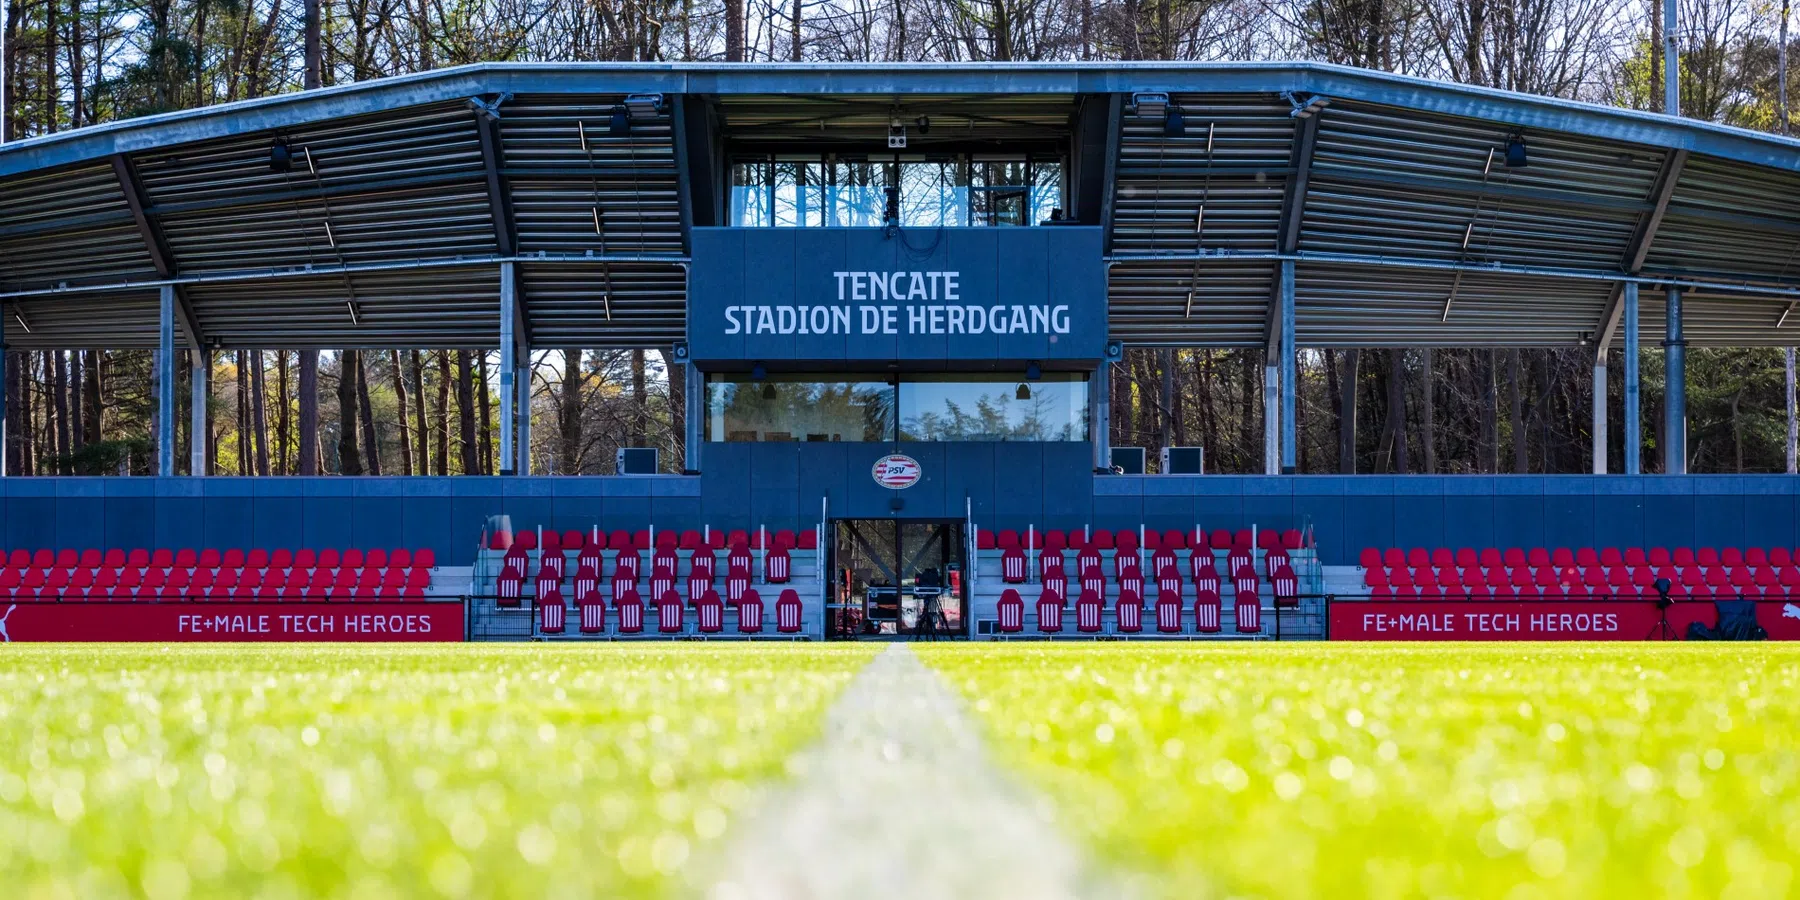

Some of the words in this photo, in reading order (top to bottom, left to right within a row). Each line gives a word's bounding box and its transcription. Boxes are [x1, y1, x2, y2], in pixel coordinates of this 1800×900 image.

[833, 271, 960, 301] TENCATE
[724, 305, 851, 335] STADION
[858, 305, 898, 335] DE
[907, 305, 1070, 335] HERDGANG
[887, 466, 906, 475] PSV
[178, 615, 270, 633] FE+MALE
[279, 615, 334, 633] TECH
[344, 615, 431, 633] HEROES
[1363, 614, 1454, 632] FE+MALE
[1464, 613, 1520, 632] TECH
[1530, 613, 1618, 632] HEROES
